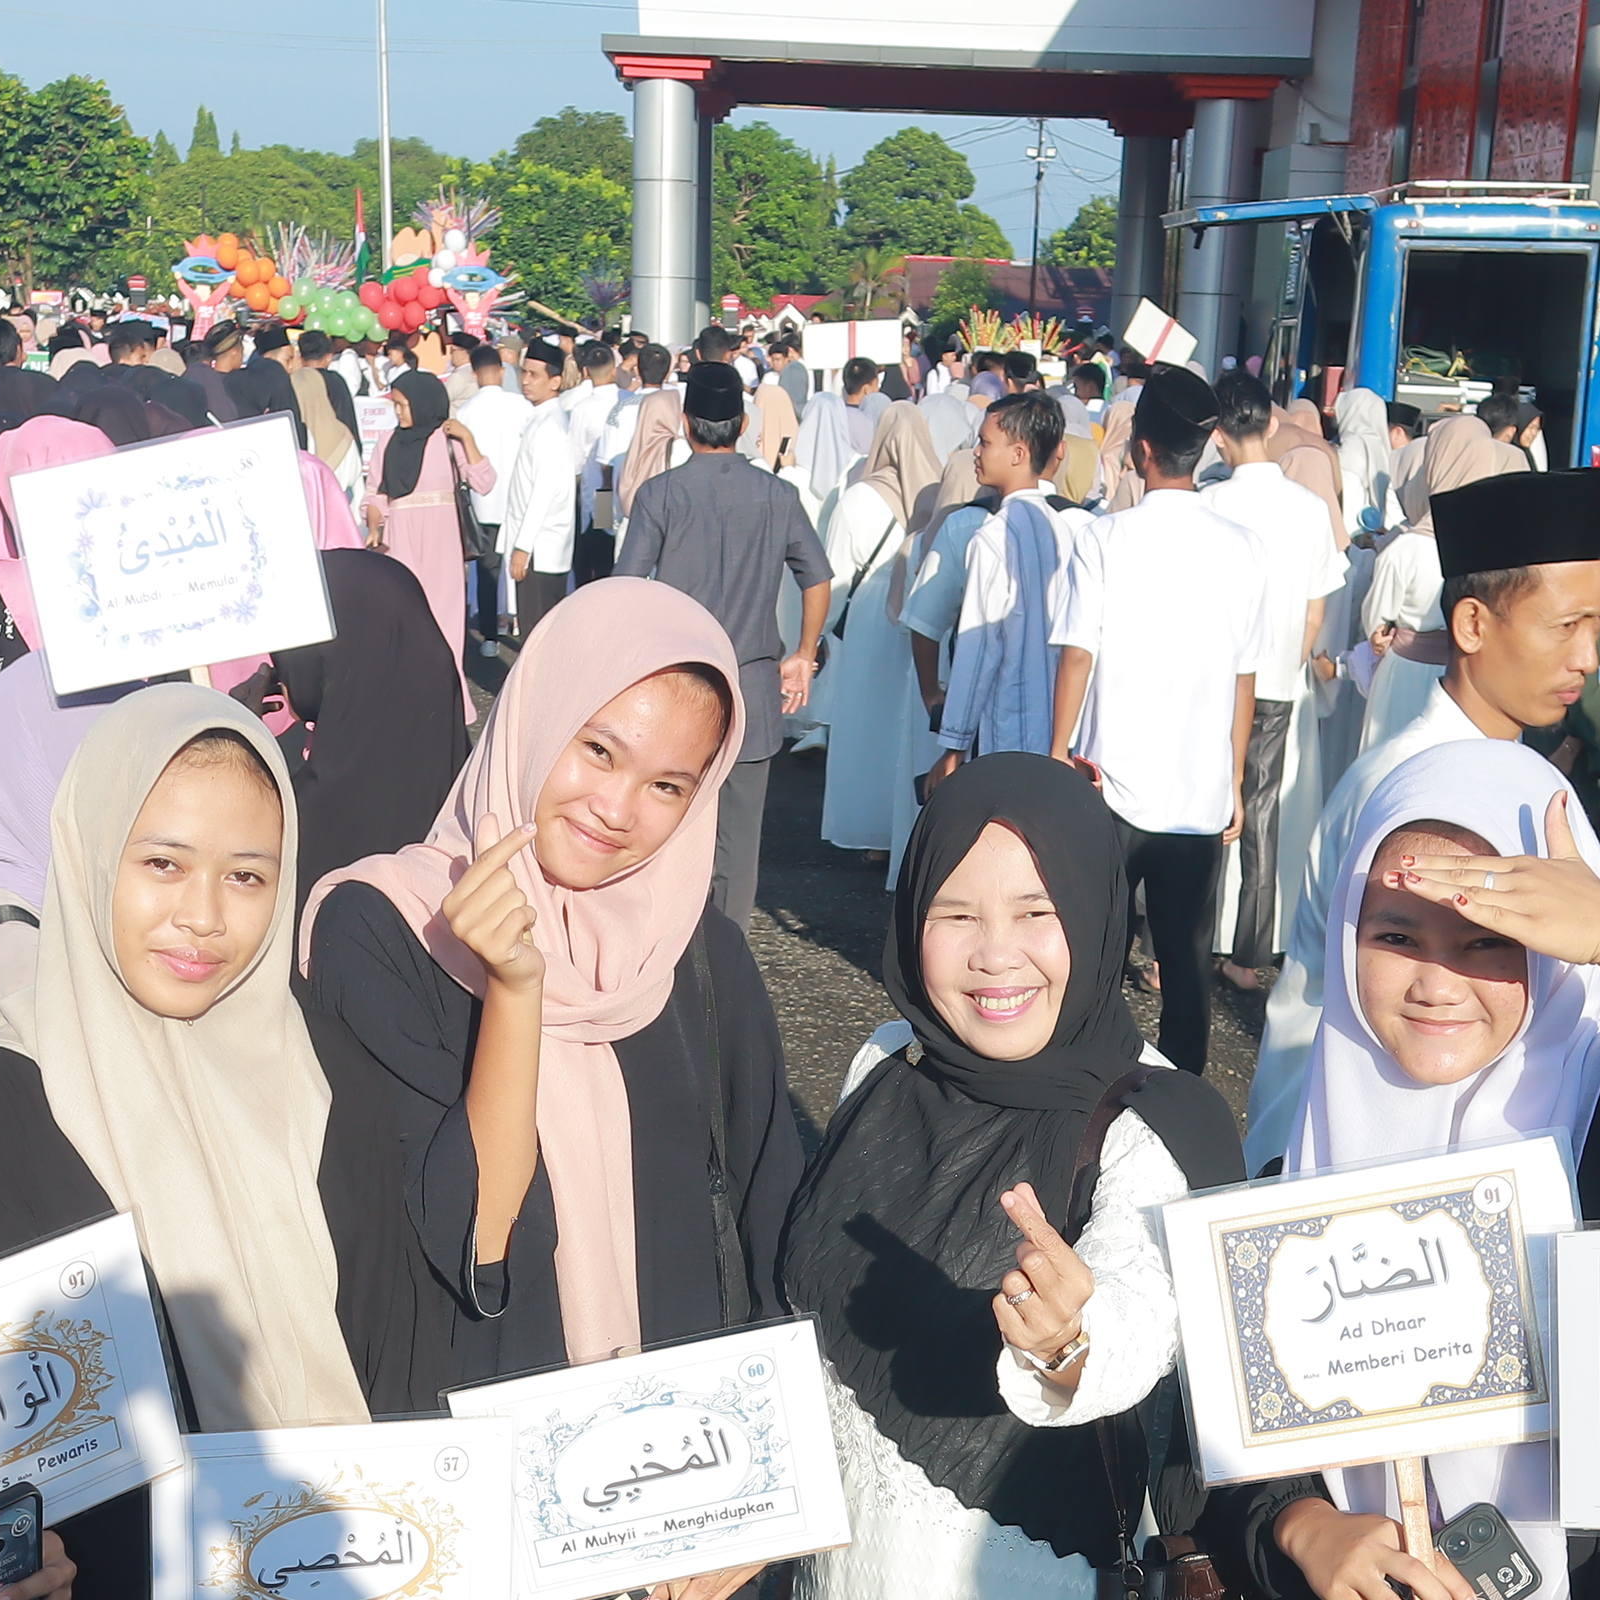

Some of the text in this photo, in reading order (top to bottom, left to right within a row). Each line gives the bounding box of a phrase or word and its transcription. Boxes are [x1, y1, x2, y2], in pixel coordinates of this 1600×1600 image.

[240, 457, 254, 471] 58
[106, 597, 119, 610] Al
[124, 589, 163, 606] Mubdi
[188, 574, 239, 594] Memulai
[1482, 1187, 1501, 1205] 91
[68, 1269, 87, 1291] 97
[1339, 1314, 1427, 1342] Ad Dhaar
[1327, 1349, 1406, 1377] Memberi
[1413, 1339, 1474, 1364] Derita
[746, 1363, 766, 1379] 60
[37, 1437, 100, 1473] Pewaris
[442, 1456, 460, 1473] 57
[561, 1539, 577, 1555] Al
[584, 1527, 637, 1554] Muhyii
[663, 1499, 776, 1534] Menghidupkan
